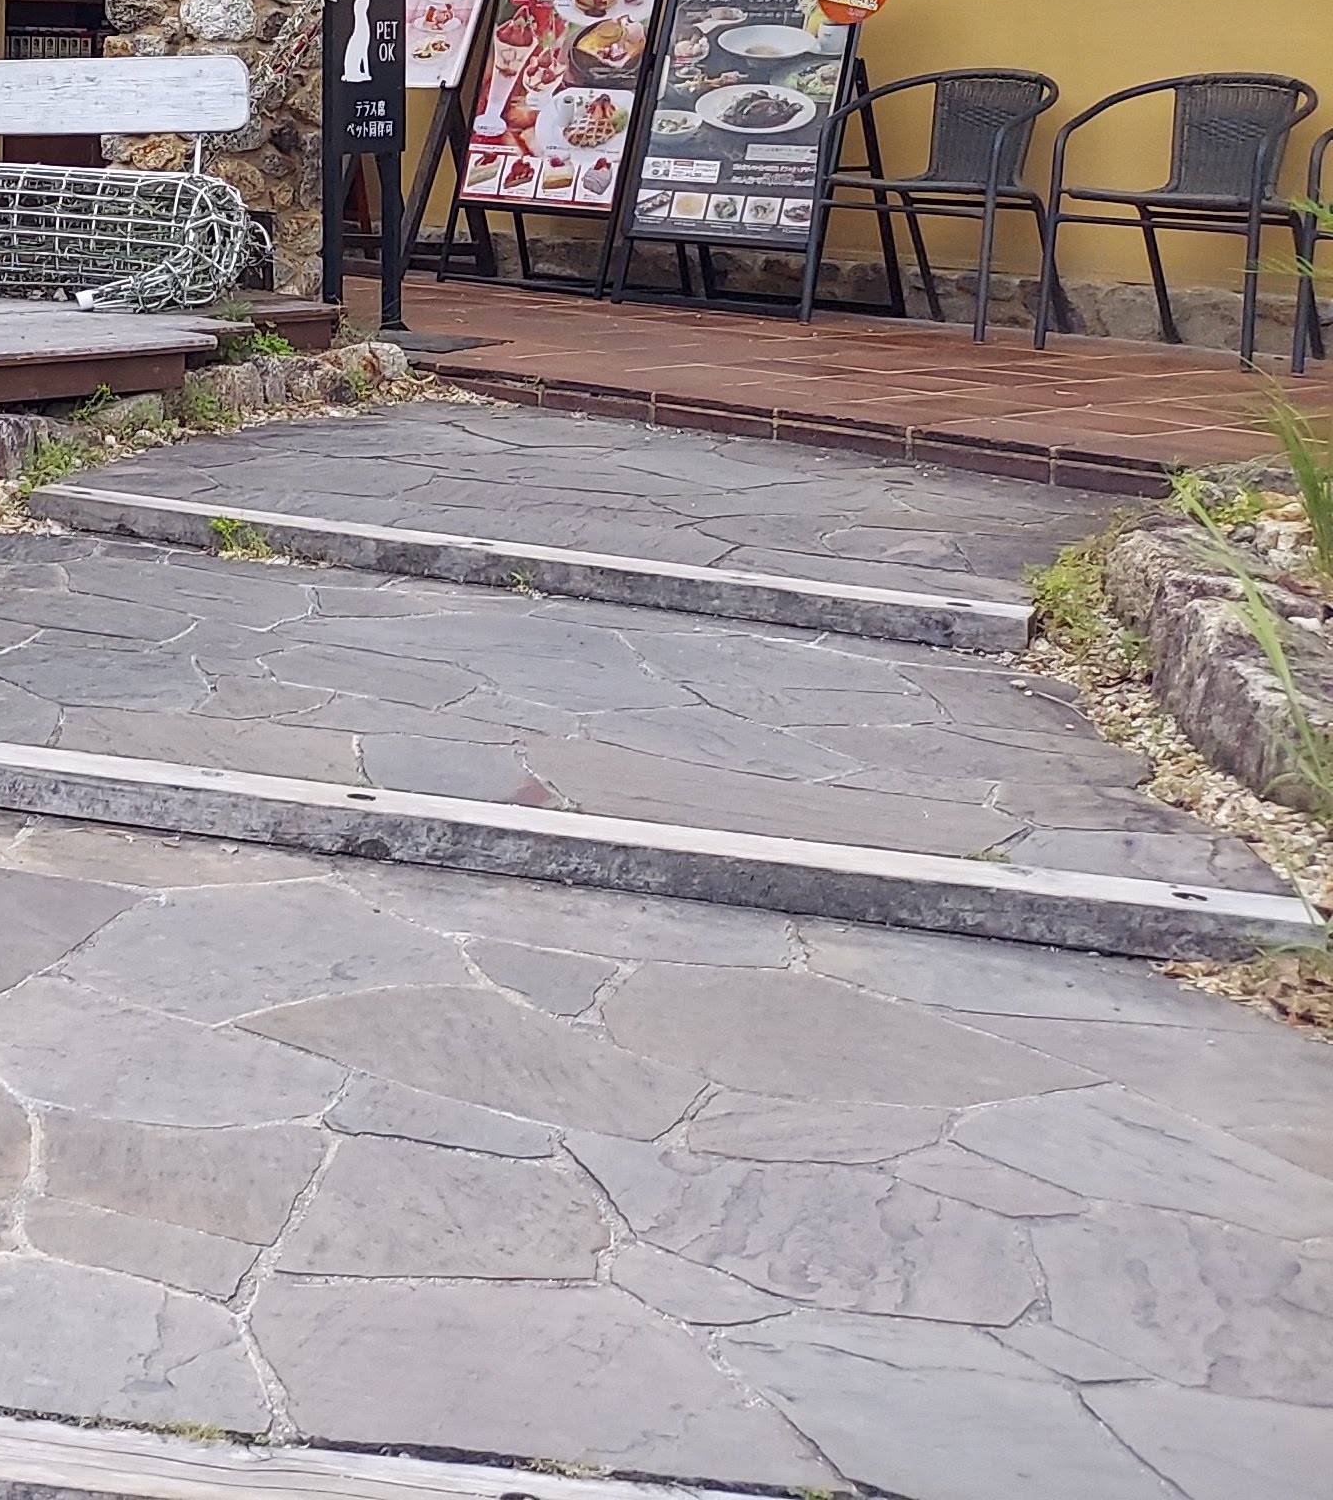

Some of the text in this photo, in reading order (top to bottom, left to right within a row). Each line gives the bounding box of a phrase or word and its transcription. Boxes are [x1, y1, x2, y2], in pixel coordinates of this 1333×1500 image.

[376, 20, 399, 40] PET
[378, 42, 396, 62] OK
[355, 100, 386, 117] テラス席
[346, 120, 393, 138] ペット同伴可
